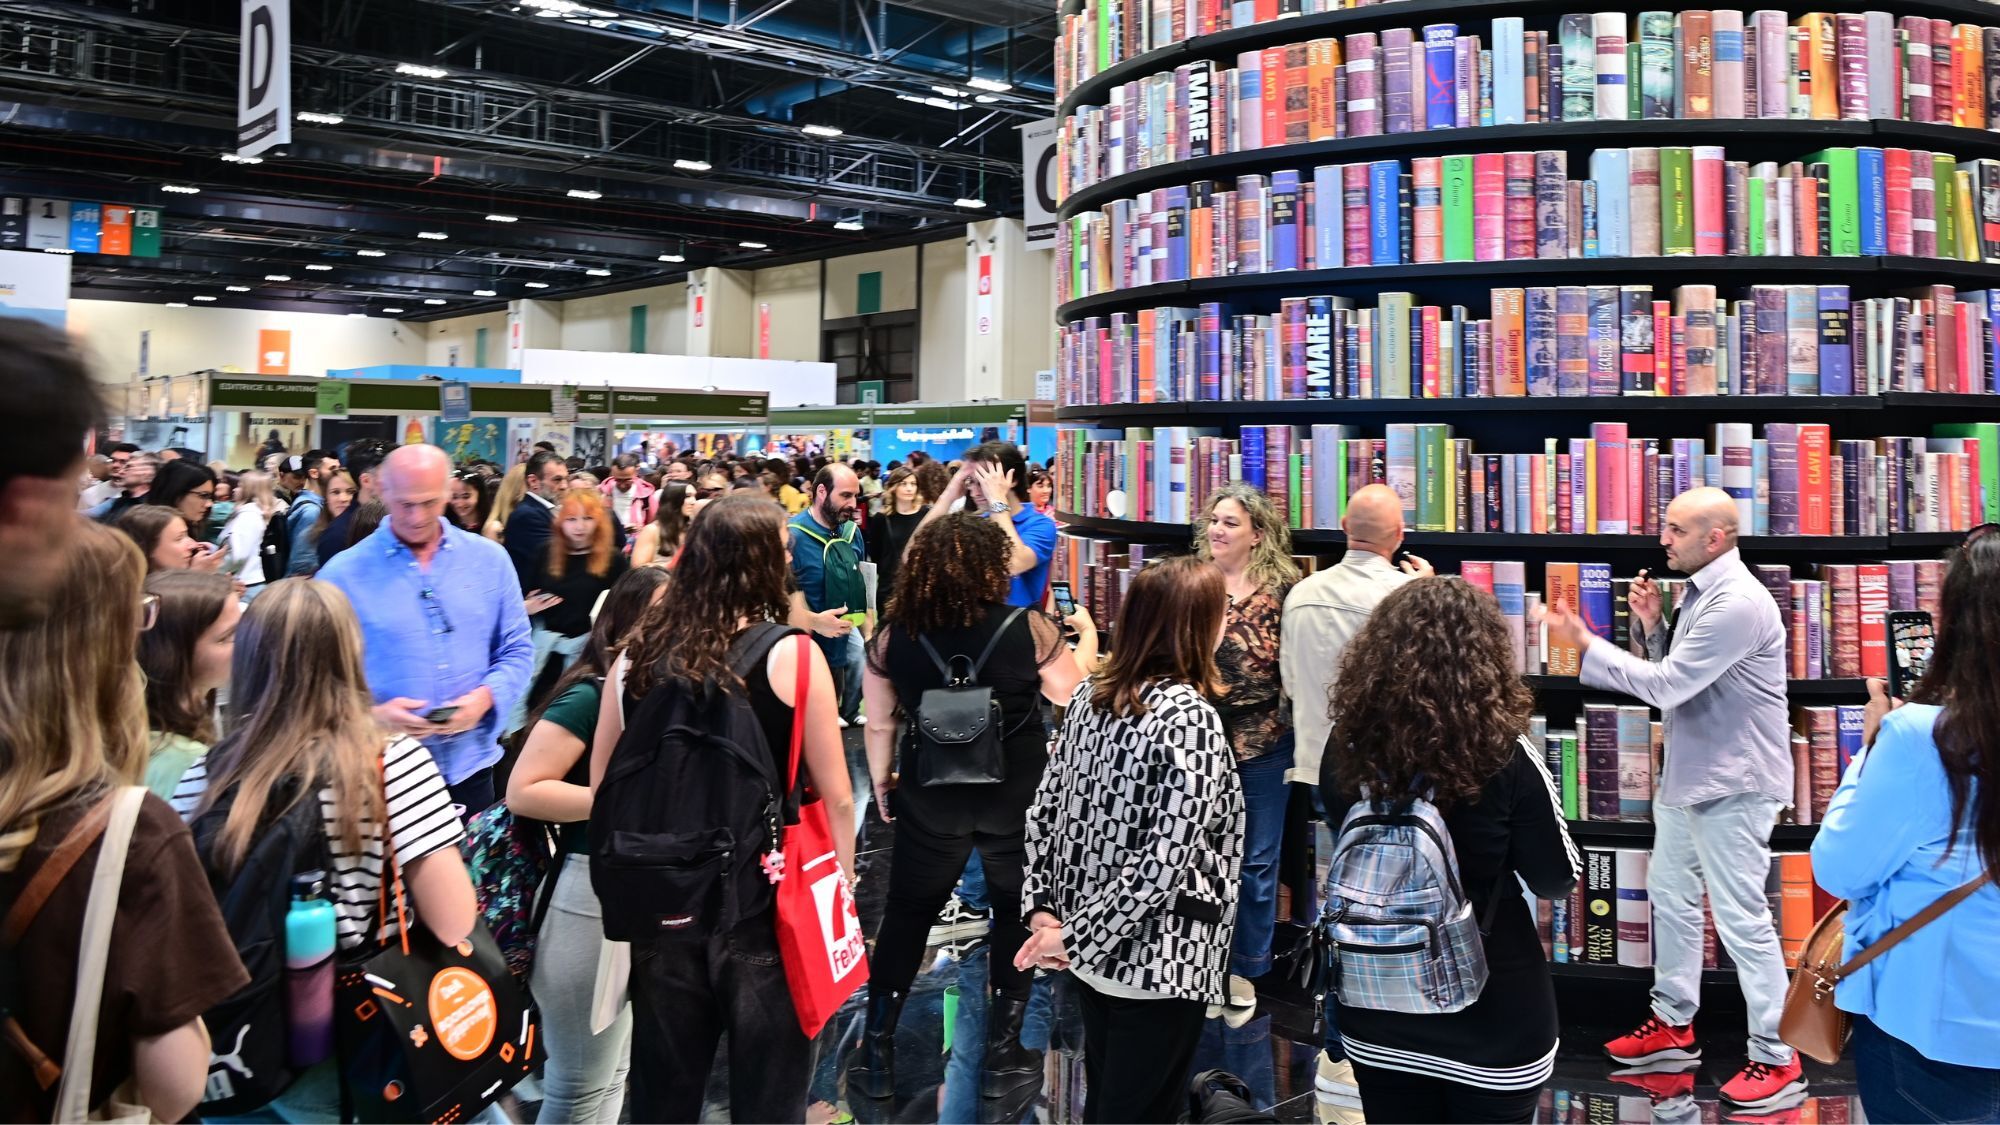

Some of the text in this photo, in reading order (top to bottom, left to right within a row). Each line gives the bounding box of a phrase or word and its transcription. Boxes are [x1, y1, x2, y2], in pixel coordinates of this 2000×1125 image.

[1427, 29, 1454, 39] 1000
[249, 5, 273, 111] D
[1266, 70, 1277, 101] CLAVE
[1189, 71, 1209, 142] MARE
[1377, 170, 1386, 201] Azzurro
[1872, 176, 1882, 214] Cucchiaio
[1377, 202, 1386, 238] Cucchiaio
[1873, 215, 1884, 246] Azzurro
[1597, 323, 1612, 342] DEGLI
[1306, 314, 1331, 386] MARE
[1598, 344, 1614, 373] SEGRETO
[219, 382, 264, 391] EDITRICE
[1573, 458, 1583, 494] THOUSAND
[1807, 451, 1822, 485] CLAVE
[1573, 495, 1584, 523] HOUNDS
[1580, 579, 1611, 589] chairs
[1582, 569, 1610, 579] 1000
[1809, 593, 1819, 622] HOUNDS
[1860, 582, 1889, 624] KING
[1810, 623, 1820, 659] THOUSAND
[1549, 645, 1561, 674] Joanne
[1563, 646, 1577, 674] Harris
[1841, 710, 1865, 720] 100
[1588, 852, 1600, 890] MISSIONE
[1599, 855, 1611, 890] D'ONORE
[1587, 923, 1601, 960] BRIAN
[1600, 927, 1613, 958] HAIG
